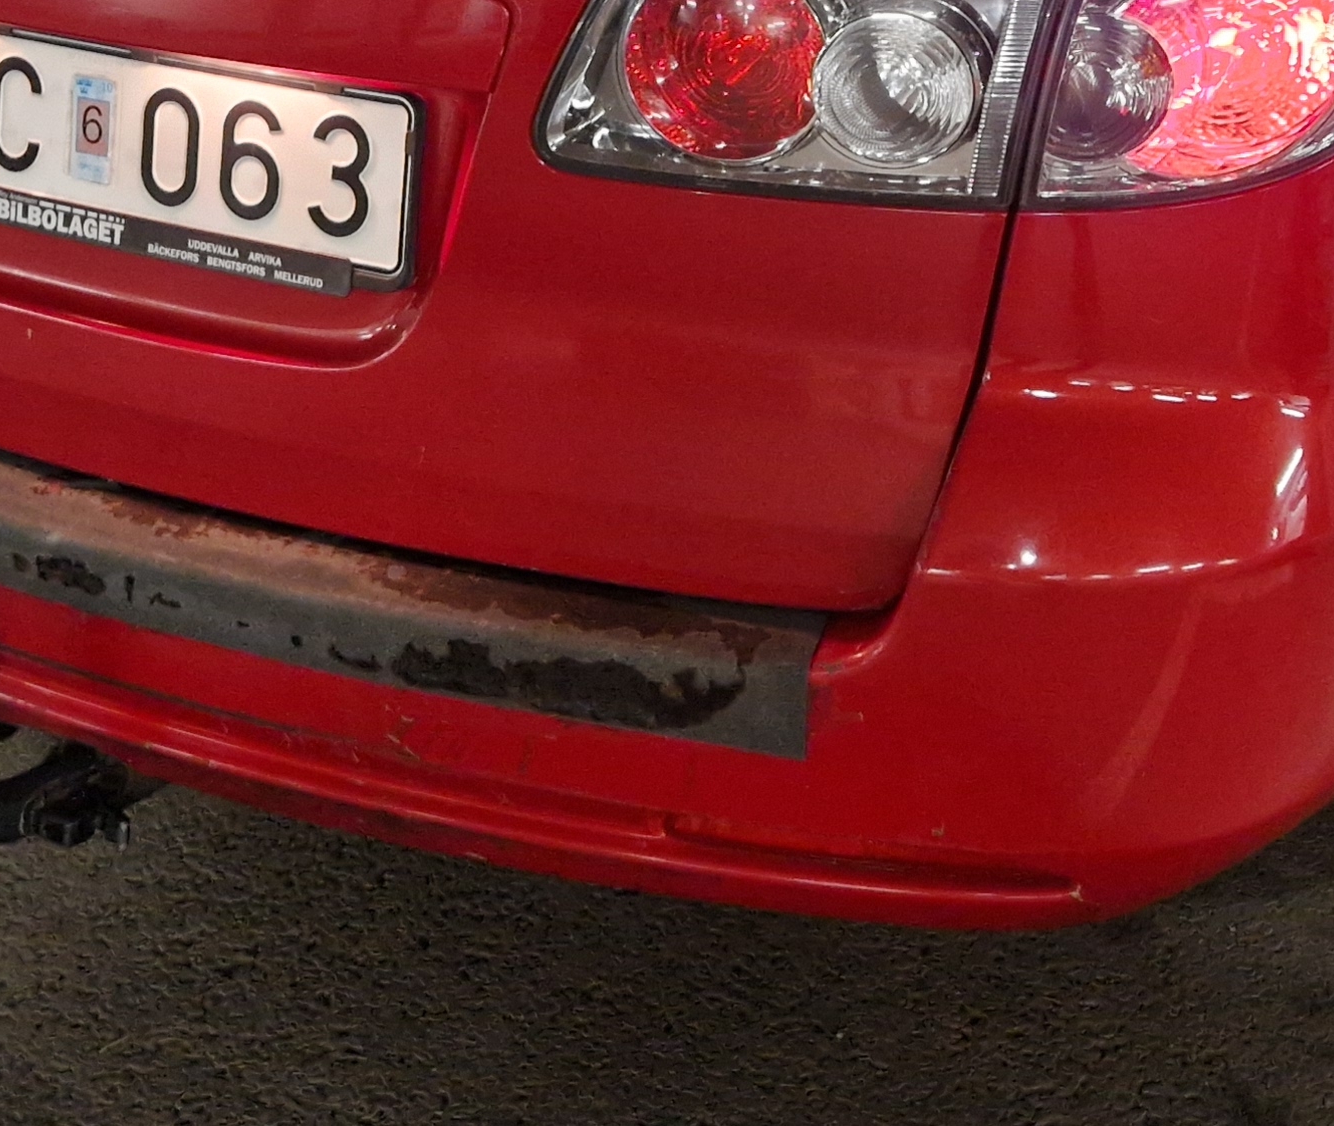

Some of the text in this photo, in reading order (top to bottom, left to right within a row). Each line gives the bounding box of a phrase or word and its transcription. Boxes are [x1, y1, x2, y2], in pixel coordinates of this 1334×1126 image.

[82, 105, 102, 144] 6
[140, 87, 371, 238] 063
[147, 243, 323, 289] BÄCKEFORS BENGTSFORS MELLERUD
[188, 239, 282, 267] UDDEVALLA ARVIKA
